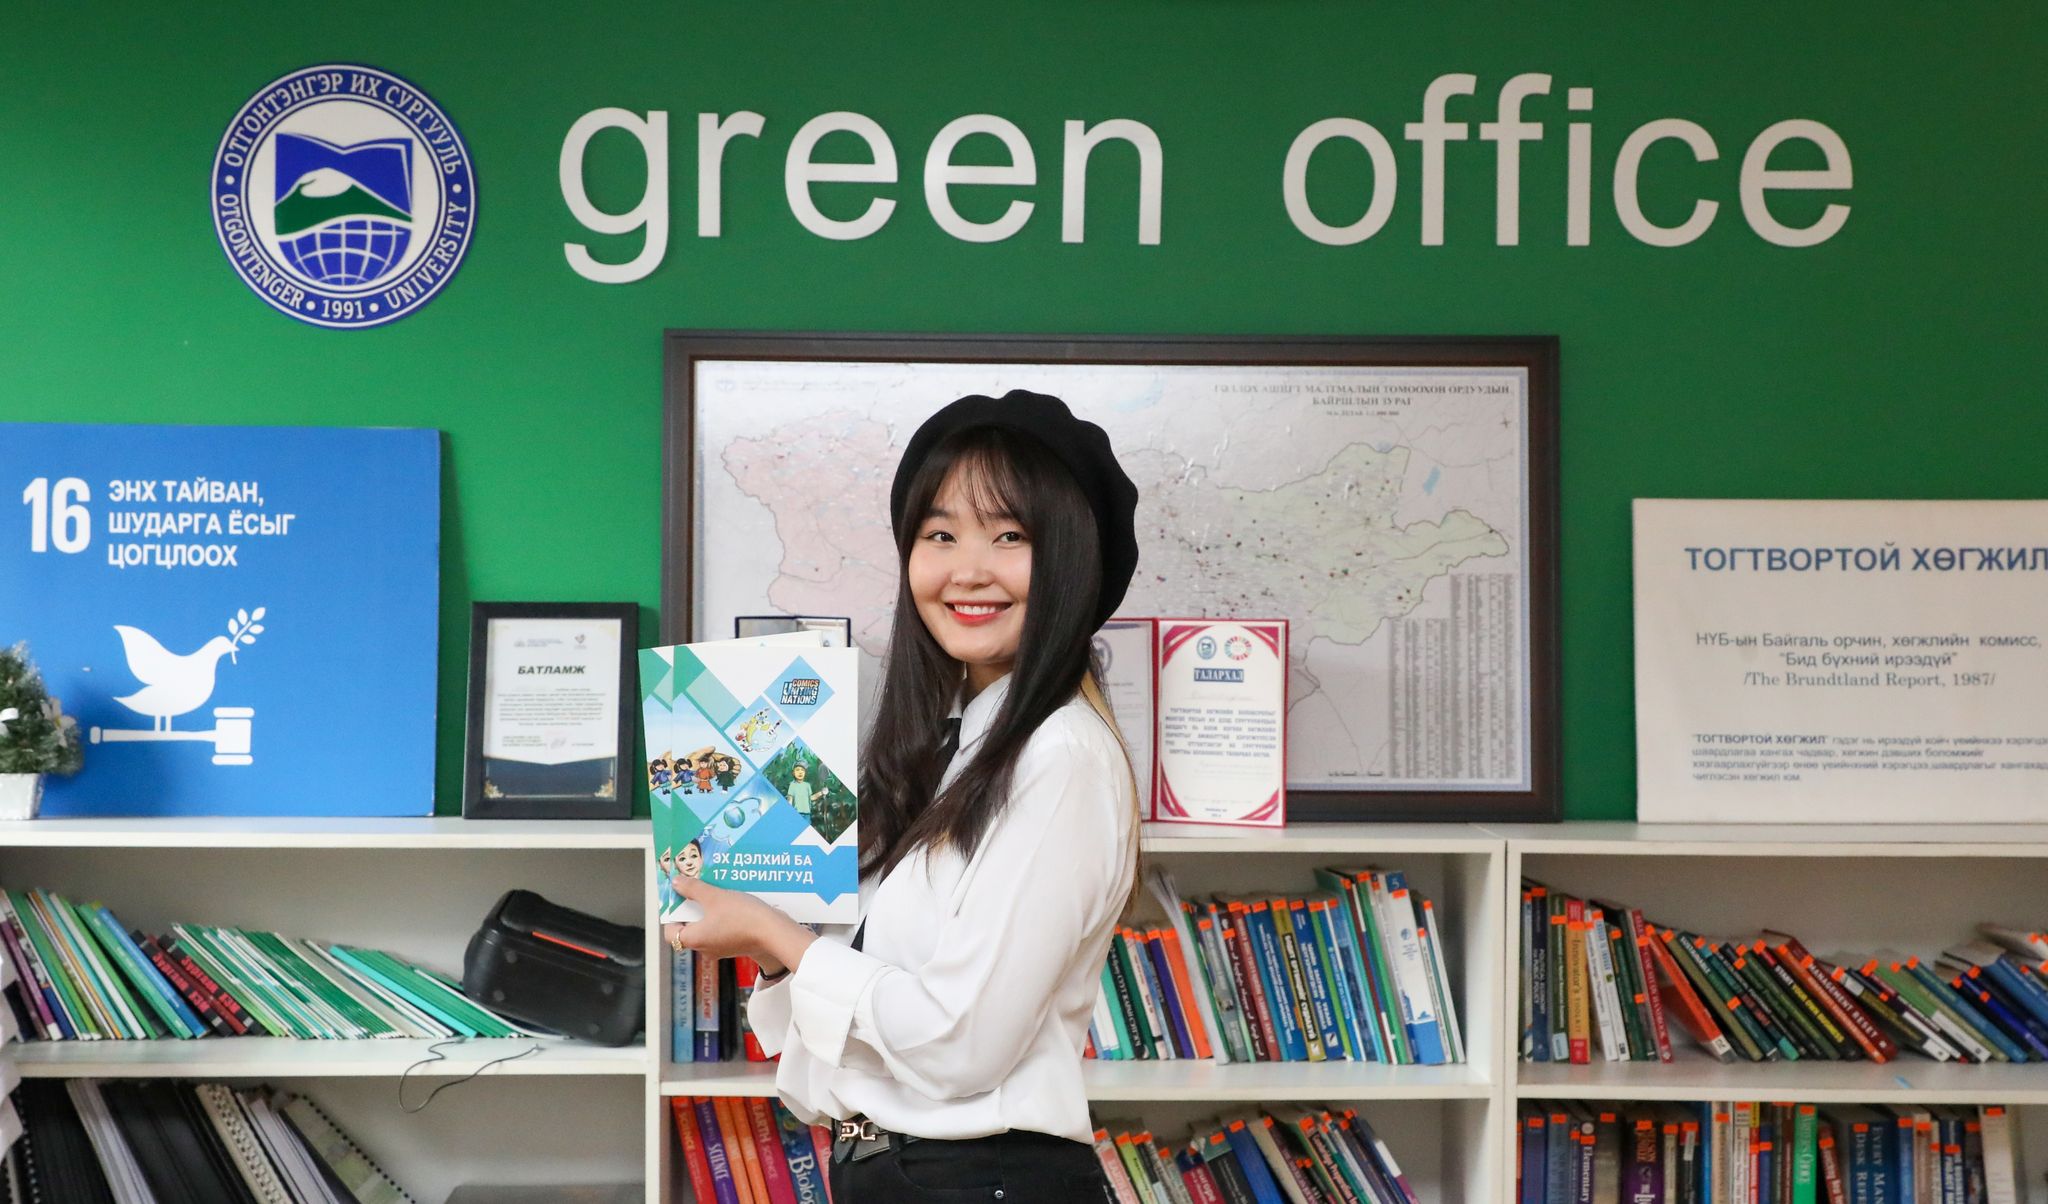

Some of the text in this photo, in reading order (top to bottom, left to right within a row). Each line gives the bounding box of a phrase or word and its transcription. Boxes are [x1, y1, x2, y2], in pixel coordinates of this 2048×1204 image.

[225, 73, 462, 174] ОТГОНТЭНГЭР ИХ СУРГУУЛЬ
[559, 72, 1854, 284] green office
[219, 193, 467, 319] OTGONTENGER 1991 UNIVERSITY
[109, 477, 264, 506] ЭНХ ТАЙВАН,
[23, 477, 91, 554] 16
[109, 509, 295, 538] ШУДАРГА ЁСЫГ
[108, 543, 238, 569] ЦОГЦЛООХ
[1684, 542, 2048, 572] ТОГТВОРТОЙ ХӨГЖИЛ
[1696, 632, 2042, 650] НҮБ-ын Байгаль орчин, хөгжлийн комисс,
[517, 665, 586, 676] БАТЛАМЖ
[1195, 669, 1244, 682] ТАЛАРХАЛ
[1821, 652, 1880, 669] бүхний
[792, 679, 819, 688] COMICS
[1743, 672, 1997, 689] /The Brundtland Report, 1987/
[781, 695, 817, 705] NATIONS
[712, 852, 813, 867] ЭХ ДЭЛХИЙ БА
[712, 869, 814, 884] 17 ЗОРИЛГУУД
[1571, 939, 1582, 993] Innovator's
[1680, 936, 1711, 975] SUSTAINABLE
[1773, 963, 1794, 986] START
[1807, 961, 1878, 1039] MANAGEMENT RESET
[678, 1111, 695, 1151] SCIENCE
[750, 1104, 779, 1180] EARTH SCIENCE
[705, 1142, 730, 1181] SCIENCE
[1855, 1132, 1868, 1166] DESK
[1193, 1166, 1216, 1203] europe
[1580, 1145, 1593, 1203] Elementary
